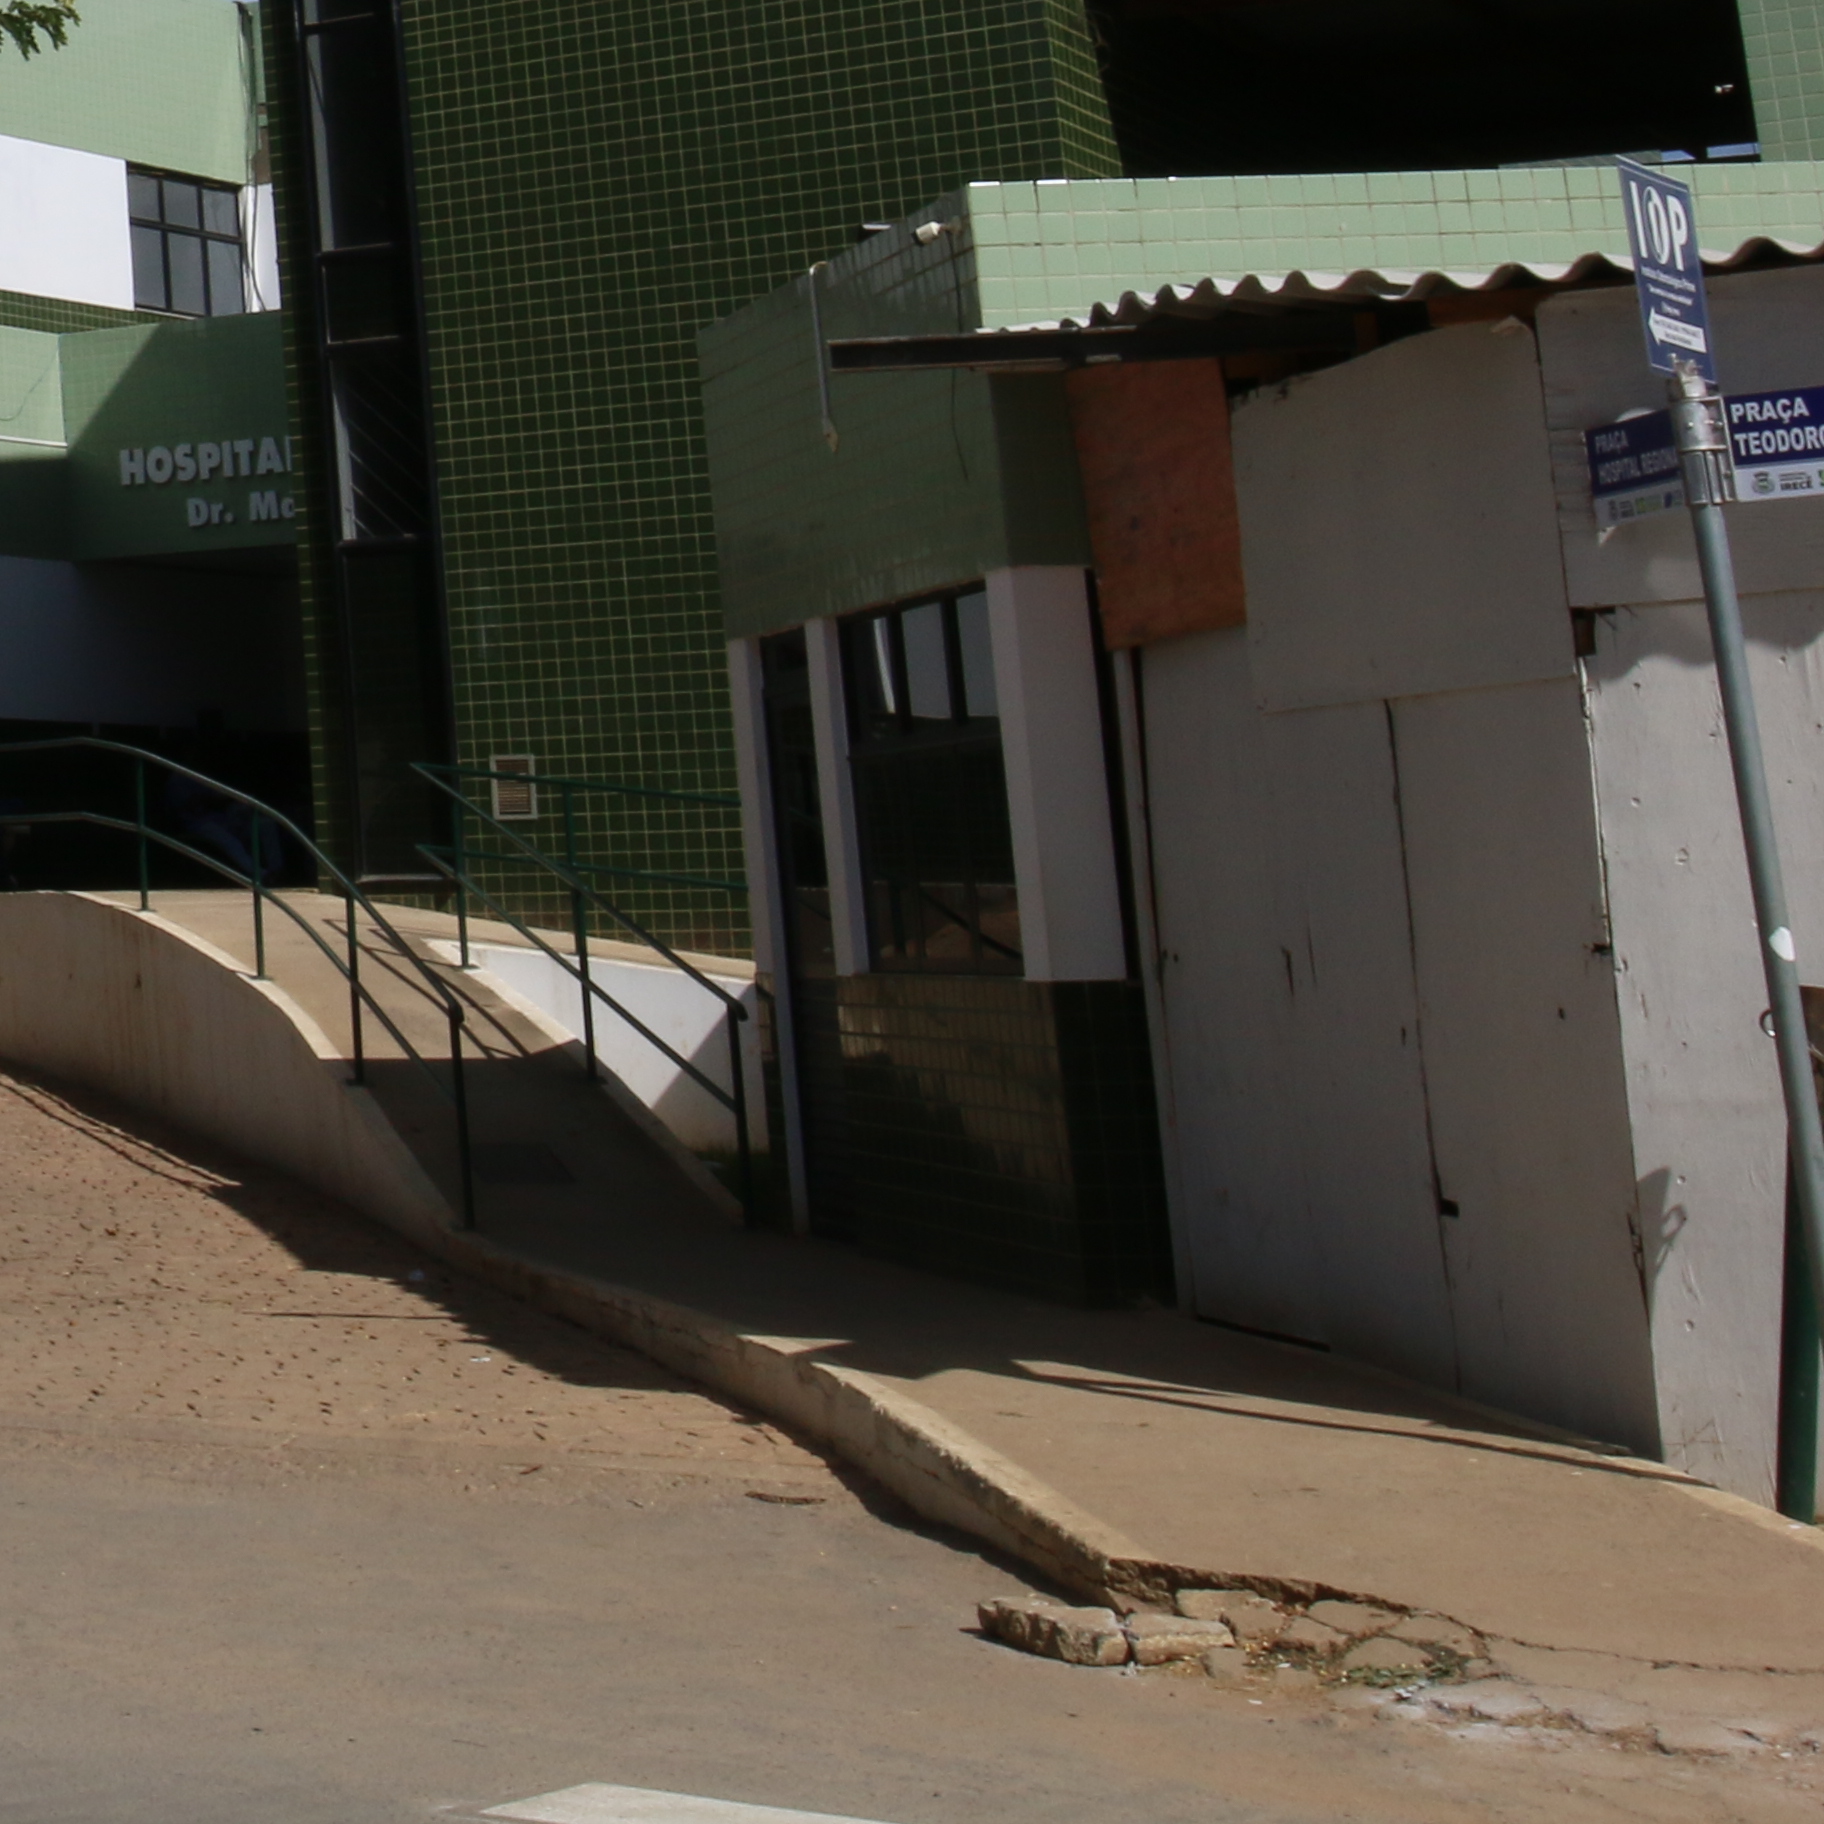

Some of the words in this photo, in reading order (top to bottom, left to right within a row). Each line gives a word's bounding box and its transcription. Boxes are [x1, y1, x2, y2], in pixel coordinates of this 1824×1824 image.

[1629, 180, 1688, 272] IOP
[1729, 396, 1811, 424] PRAÇA
[1594, 429, 1630, 455] PRAÇA
[119, 435, 292, 487] HOSPITA
[1597, 454, 1642, 486] HOSPITAL
[186, 496, 234, 528] Dr.
